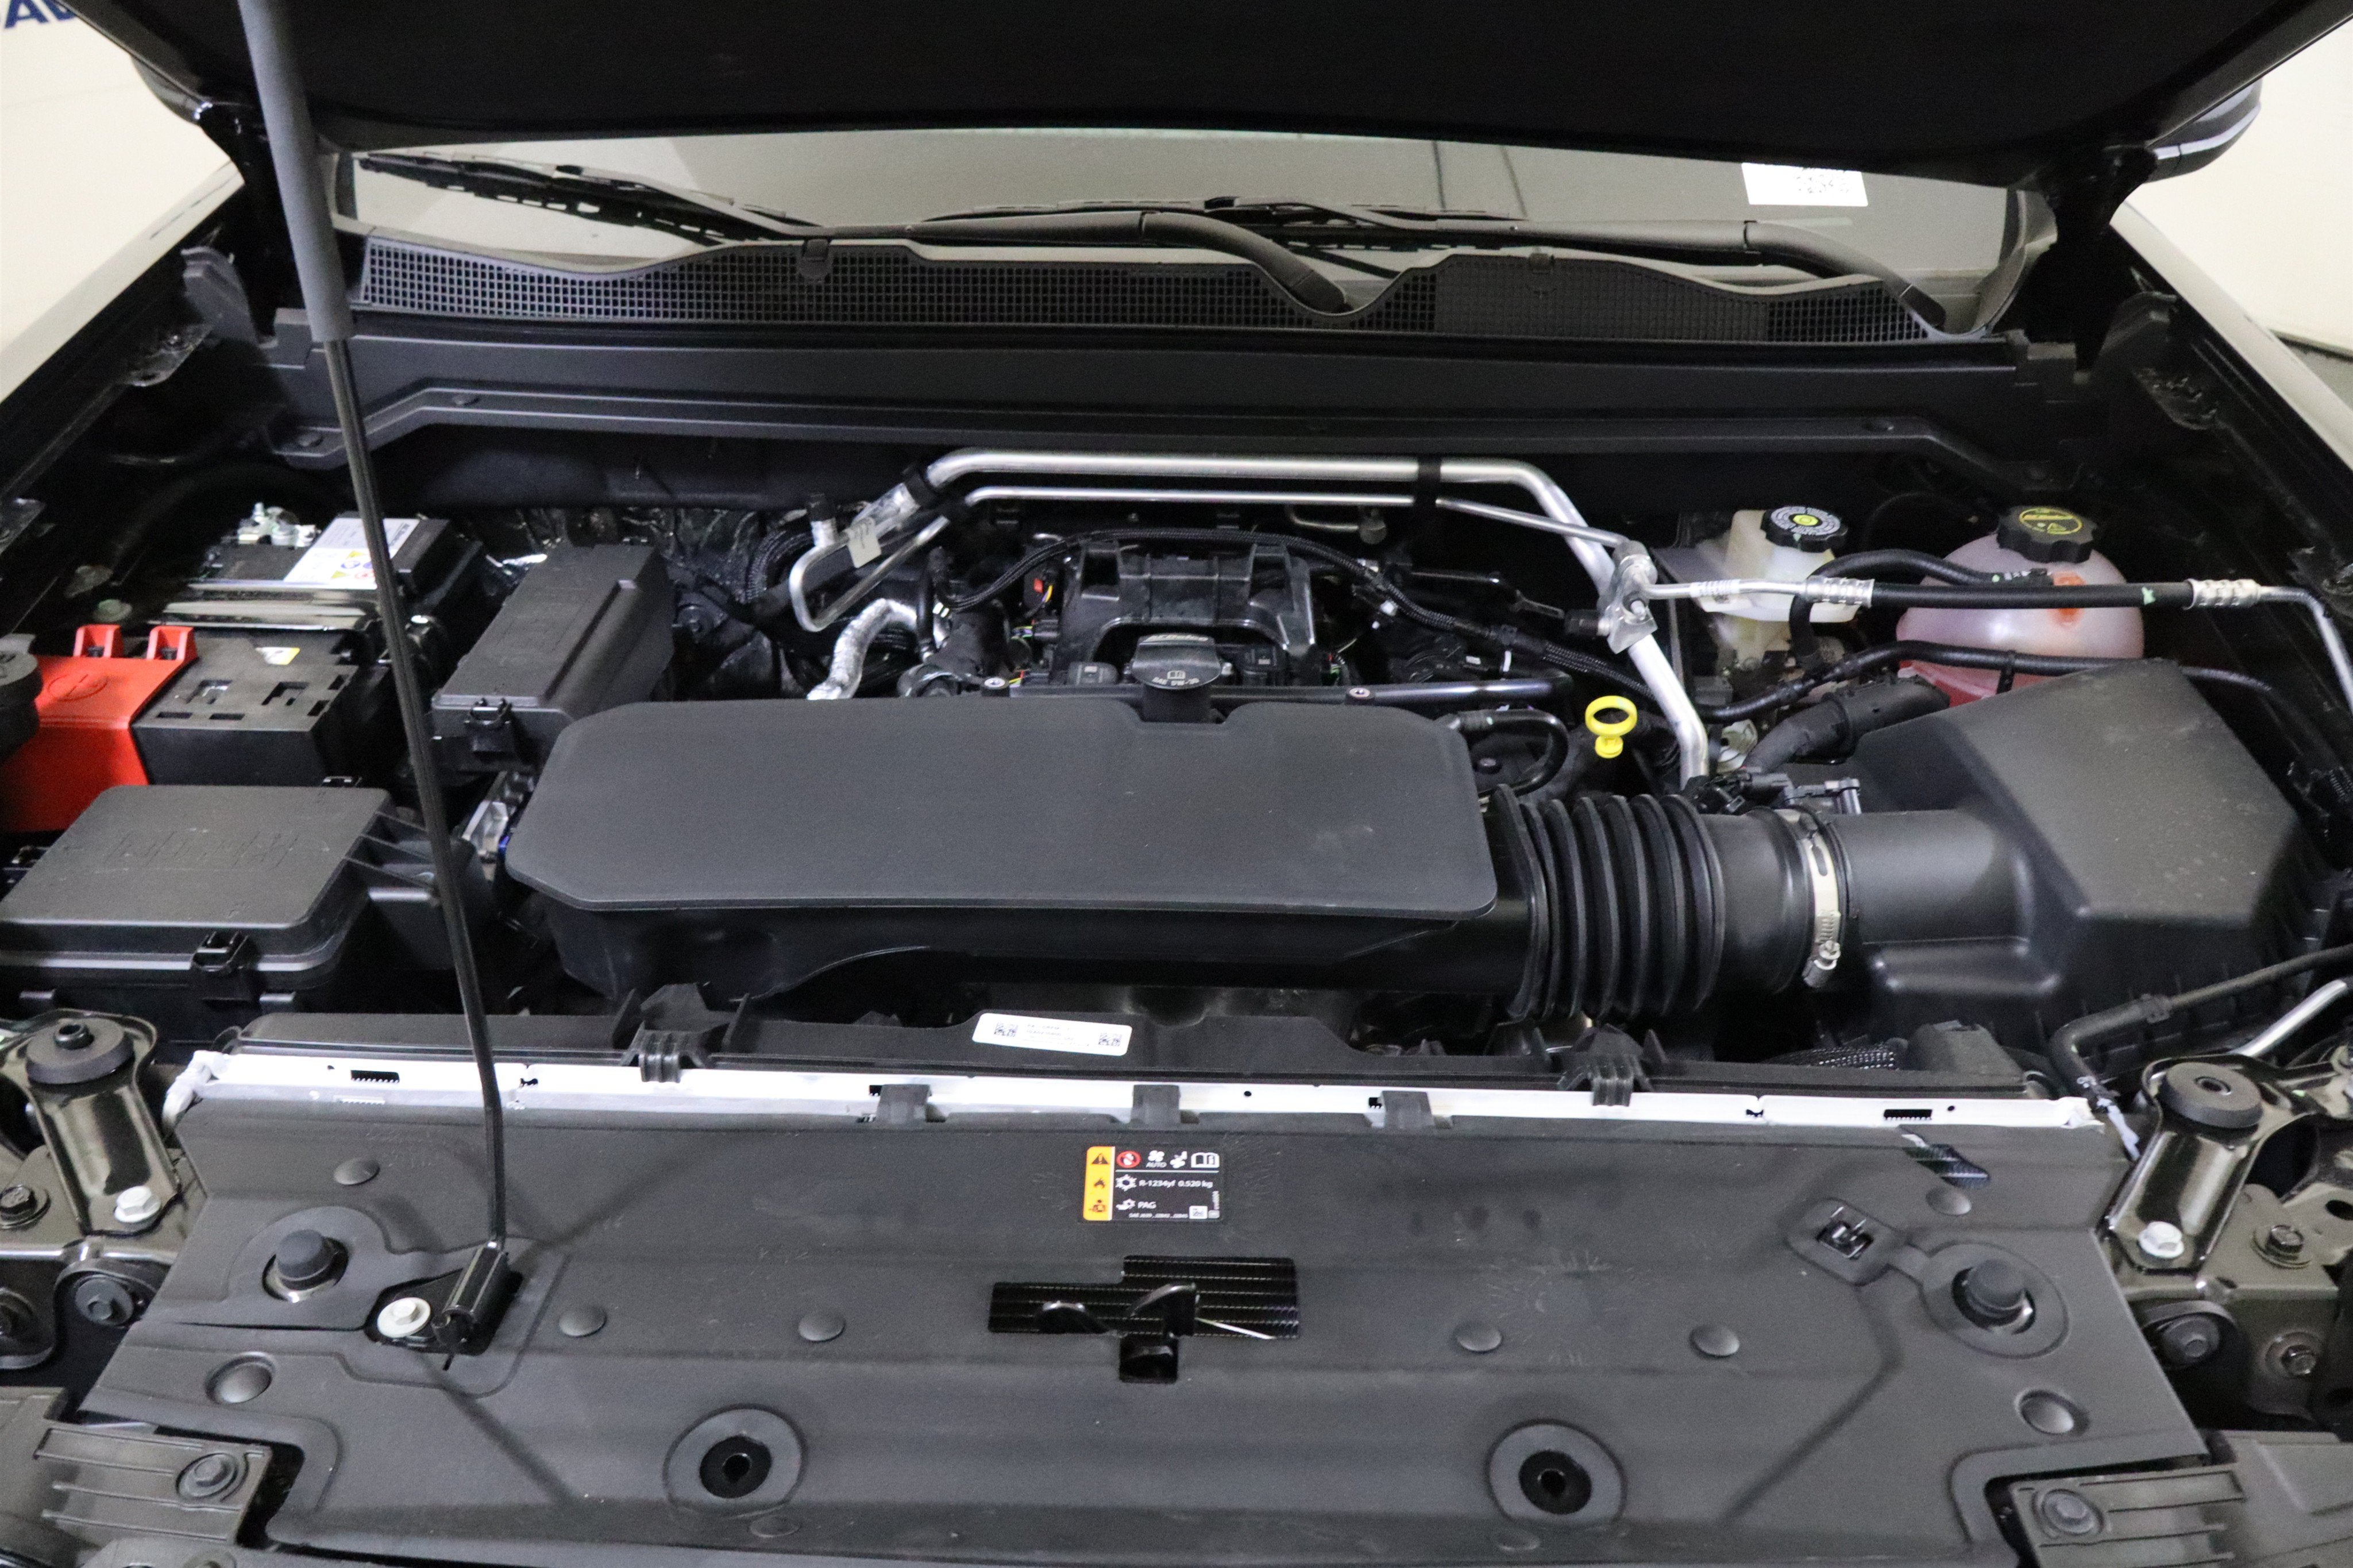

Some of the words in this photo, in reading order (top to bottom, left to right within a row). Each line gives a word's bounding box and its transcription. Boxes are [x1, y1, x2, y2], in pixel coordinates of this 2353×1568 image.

[1138, 1180, 1176, 1188] R-1234yf
[1201, 1180, 1213, 1189] kg
[1137, 1201, 1157, 1209] PAG
